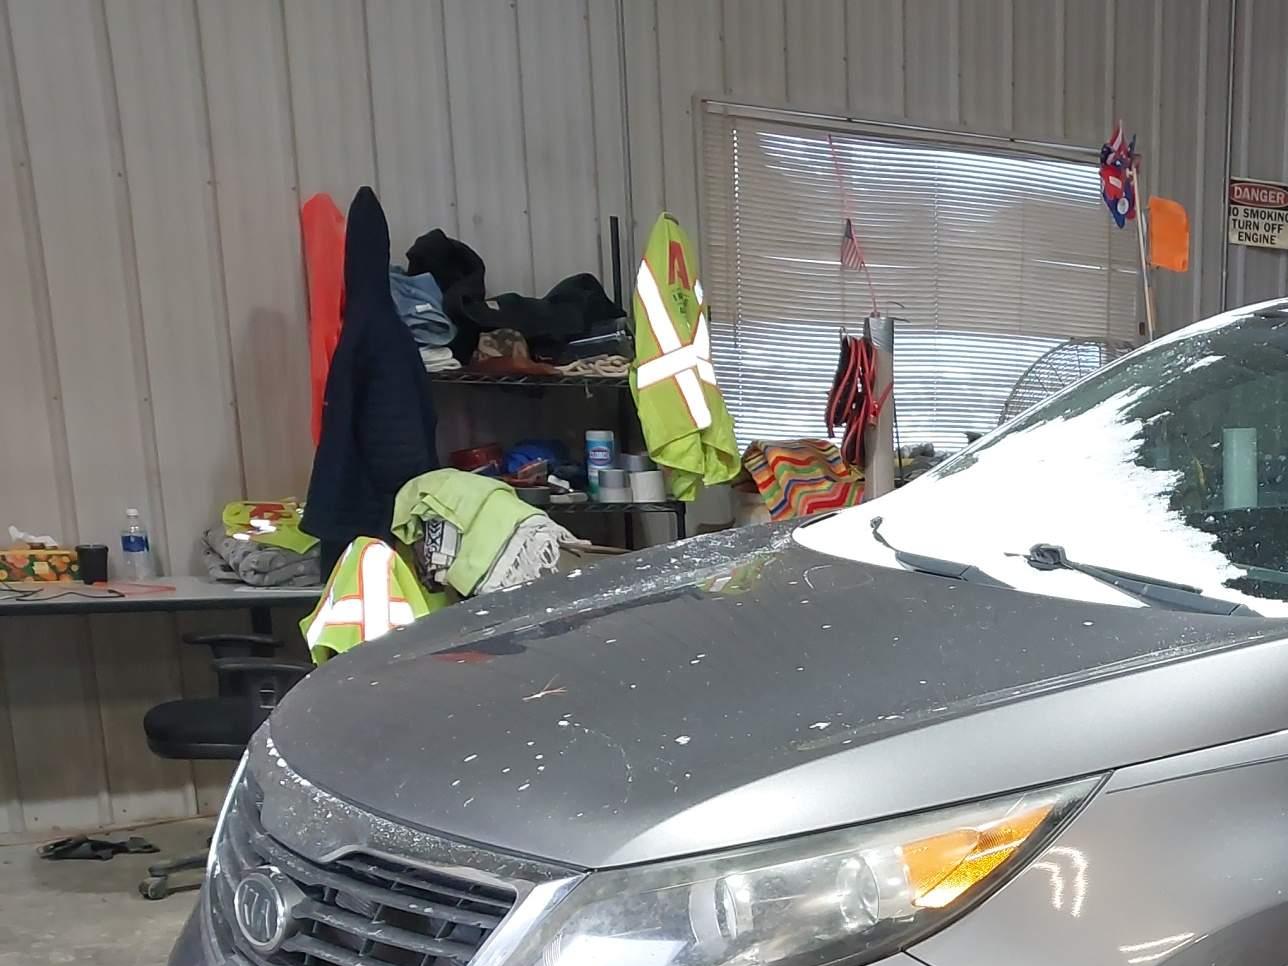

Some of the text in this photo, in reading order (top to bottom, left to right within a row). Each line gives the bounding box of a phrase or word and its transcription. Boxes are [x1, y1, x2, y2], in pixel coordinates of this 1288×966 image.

[1233, 186, 1285, 204] DANGER
[1232, 219, 1284, 234] TURN OFF
[1238, 231, 1277, 245] ENGINE
